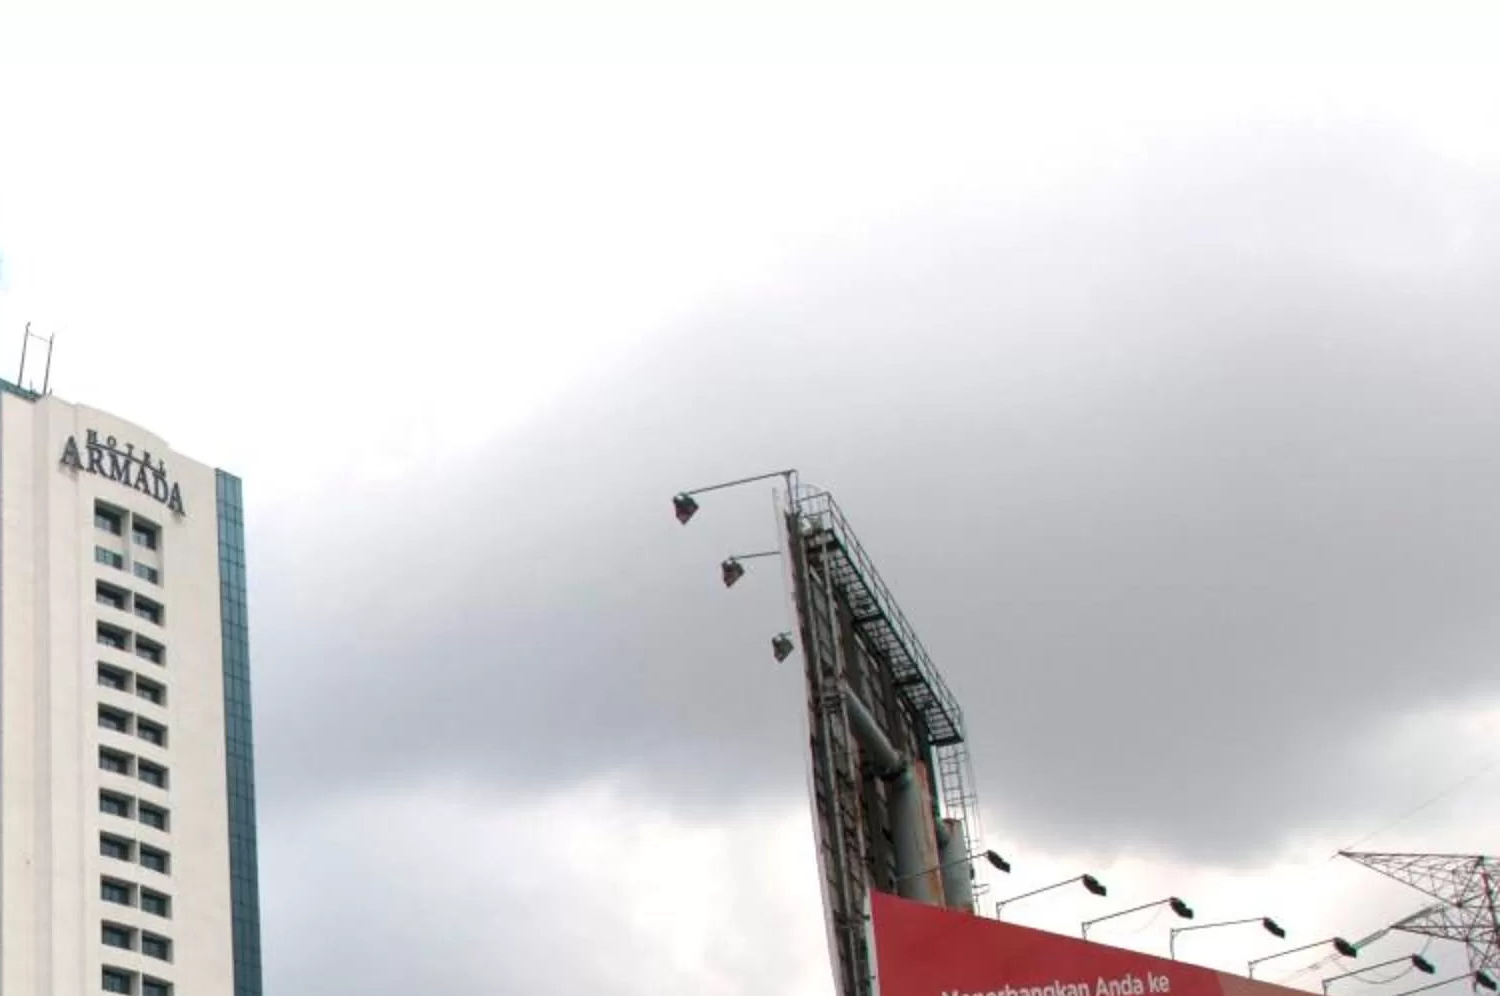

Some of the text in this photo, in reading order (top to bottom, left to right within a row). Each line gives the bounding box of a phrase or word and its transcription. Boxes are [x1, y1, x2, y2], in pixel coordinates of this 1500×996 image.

[59, 435, 186, 516] ARMADA
[86, 428, 166, 478] HOTEL
[1148, 971, 1170, 993] ke
